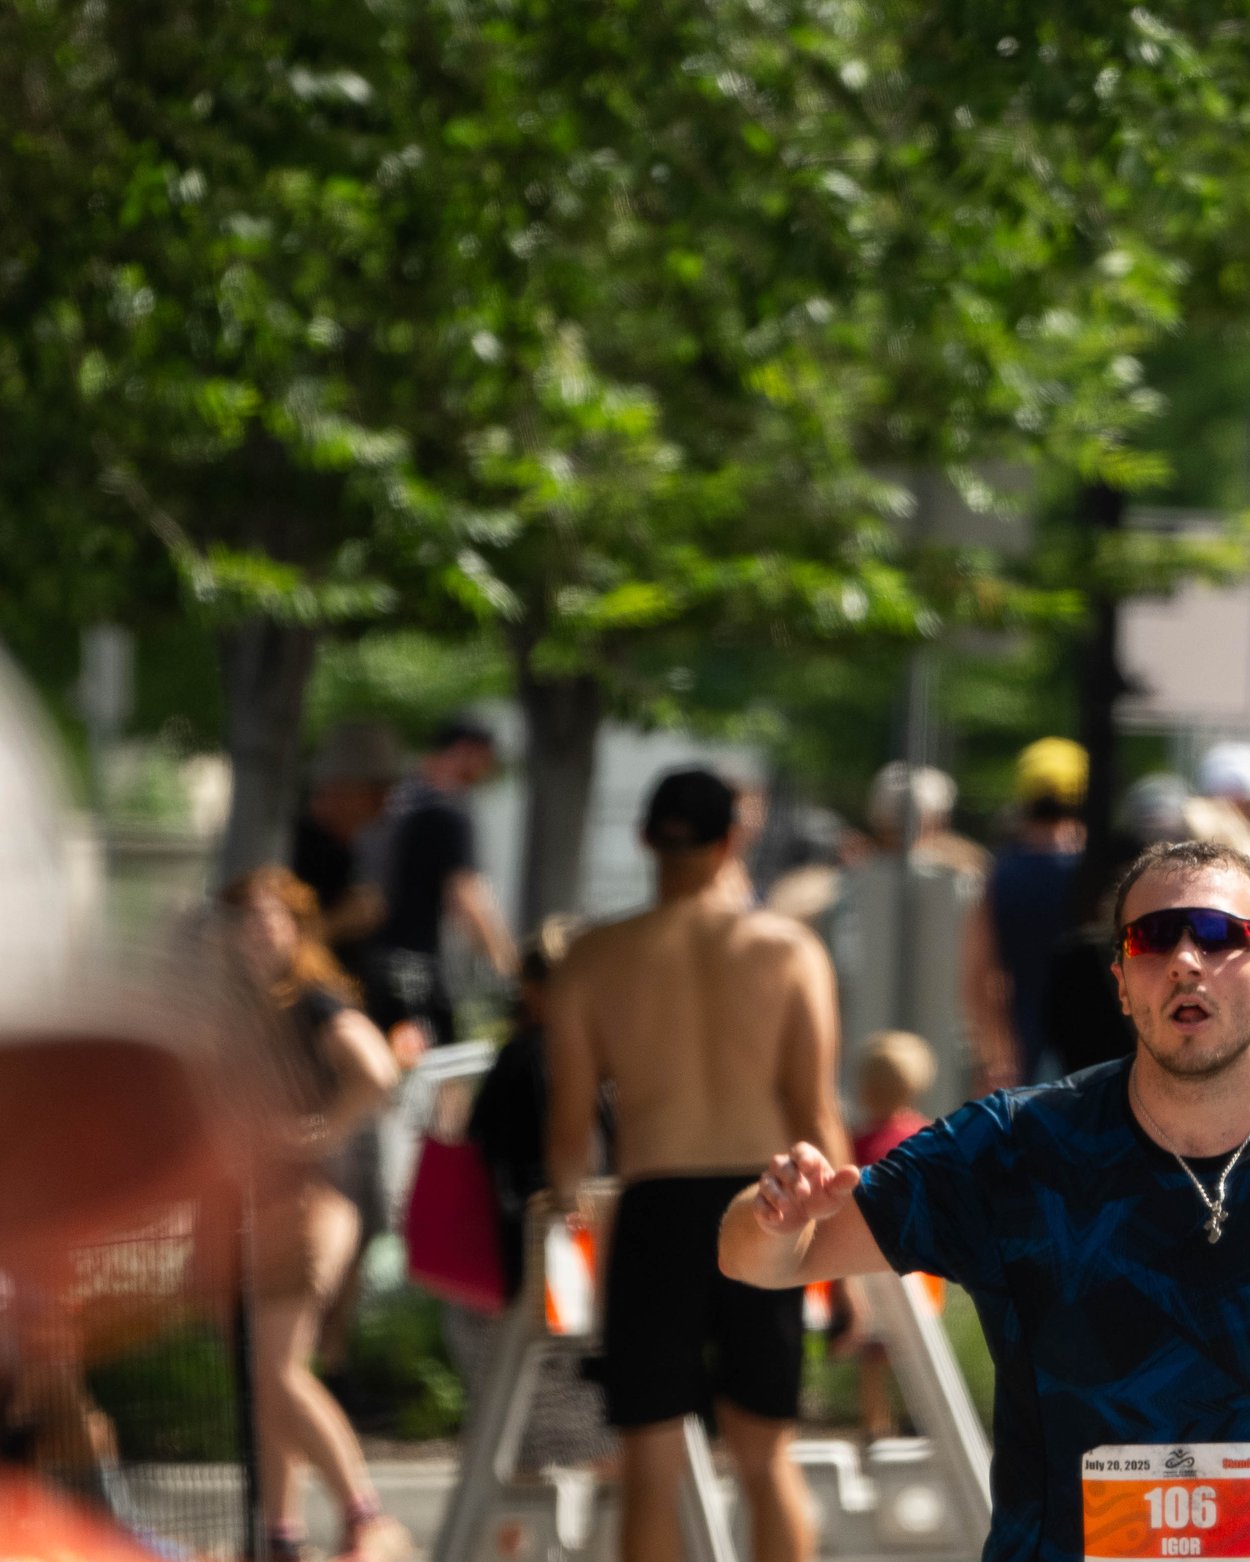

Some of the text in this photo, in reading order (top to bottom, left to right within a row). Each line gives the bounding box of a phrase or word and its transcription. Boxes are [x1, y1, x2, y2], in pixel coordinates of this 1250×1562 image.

[1085, 1459, 1105, 1472] July
[1125, 1459, 1151, 1471] 2025
[1144, 1486, 1217, 1529] 106
[1161, 1537, 1201, 1556] IGOR
